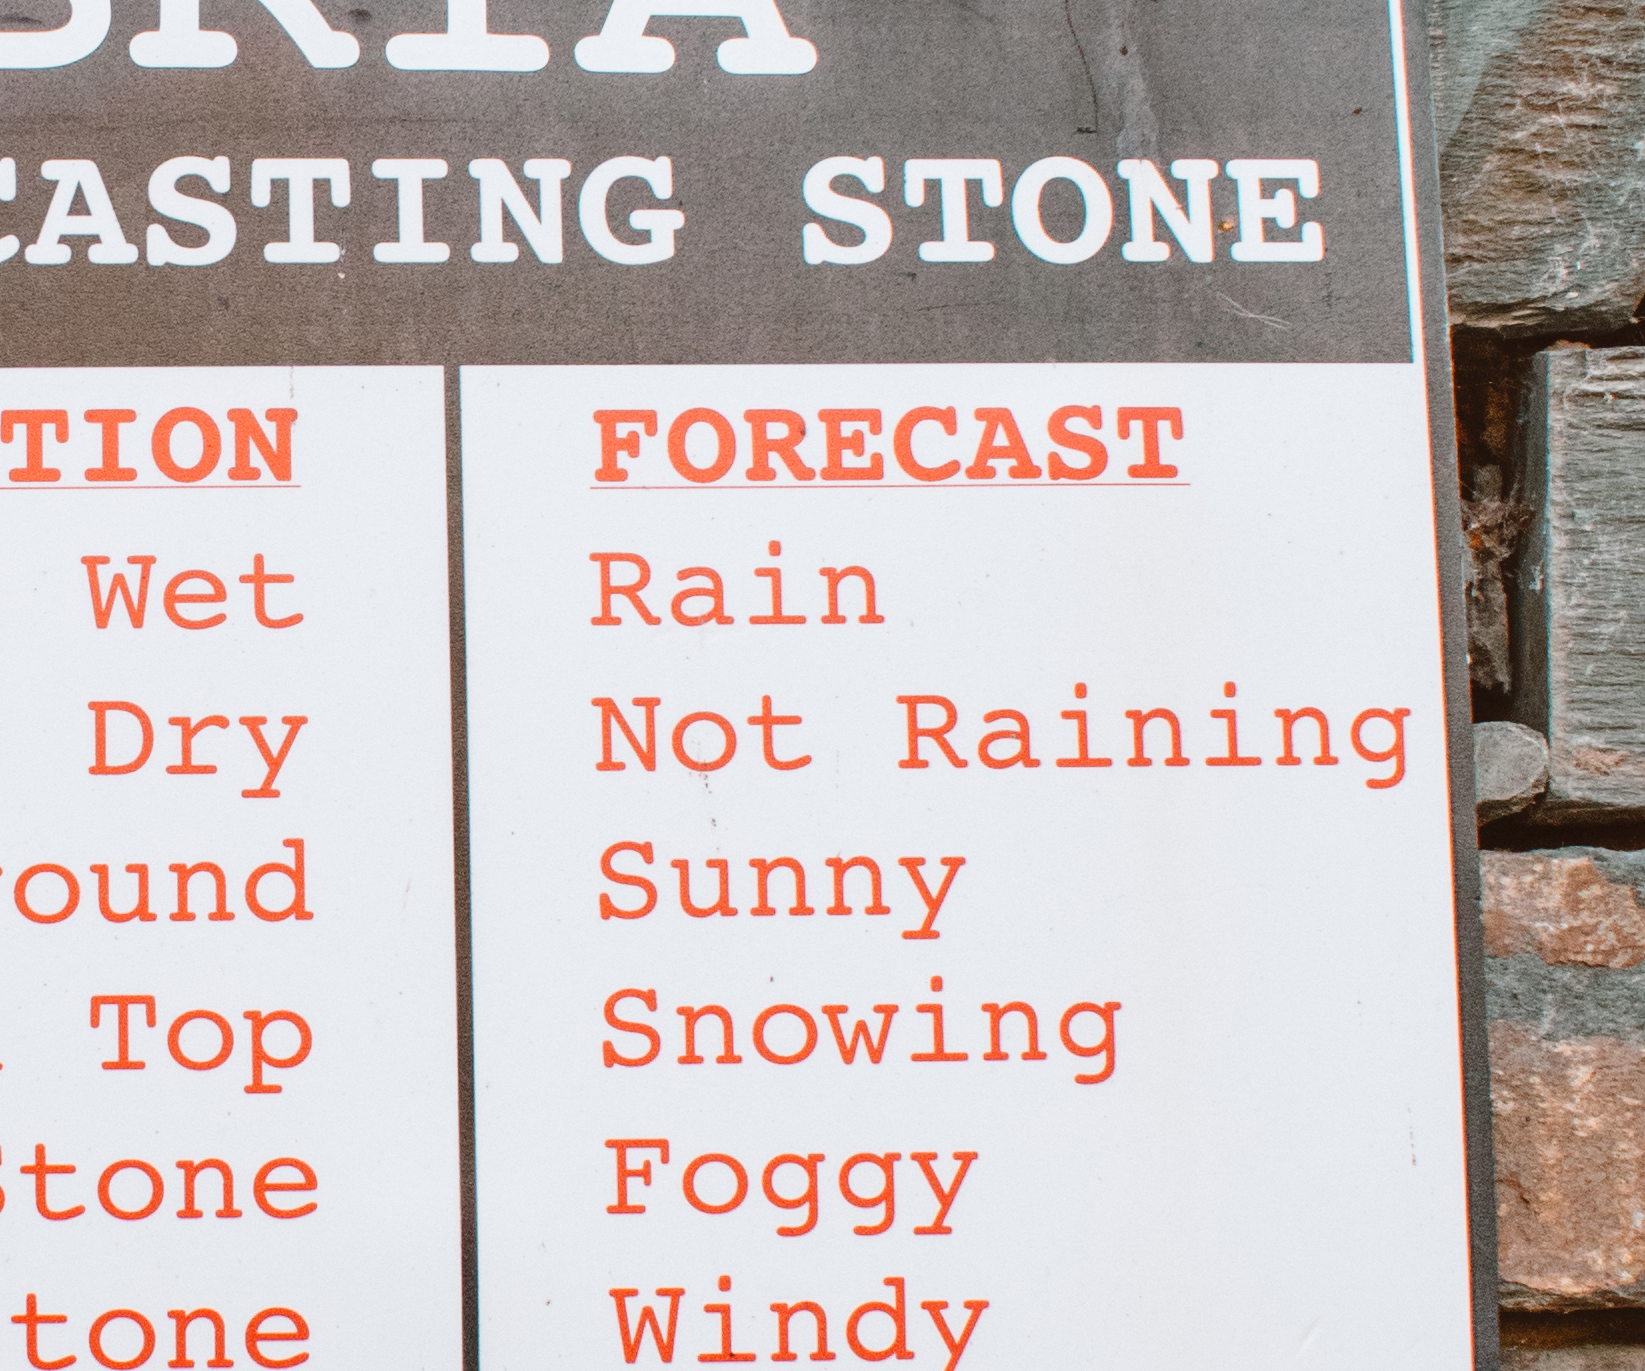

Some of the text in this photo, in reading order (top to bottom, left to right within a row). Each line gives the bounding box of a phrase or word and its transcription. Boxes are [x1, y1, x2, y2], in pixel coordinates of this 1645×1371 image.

[802, 155, 1324, 266] STONE
[592, 404, 1184, 484] FORECAST
[80, 553, 304, 630] Wet
[588, 540, 885, 627] Rain
[87, 700, 309, 799] Dry
[590, 681, 1411, 790] Not Raining
[598, 840, 966, 940] Sunny
[89, 993, 313, 1094] Top
[601, 979, 1122, 1085] Snowing
[604, 1137, 979, 1237] Foggy
